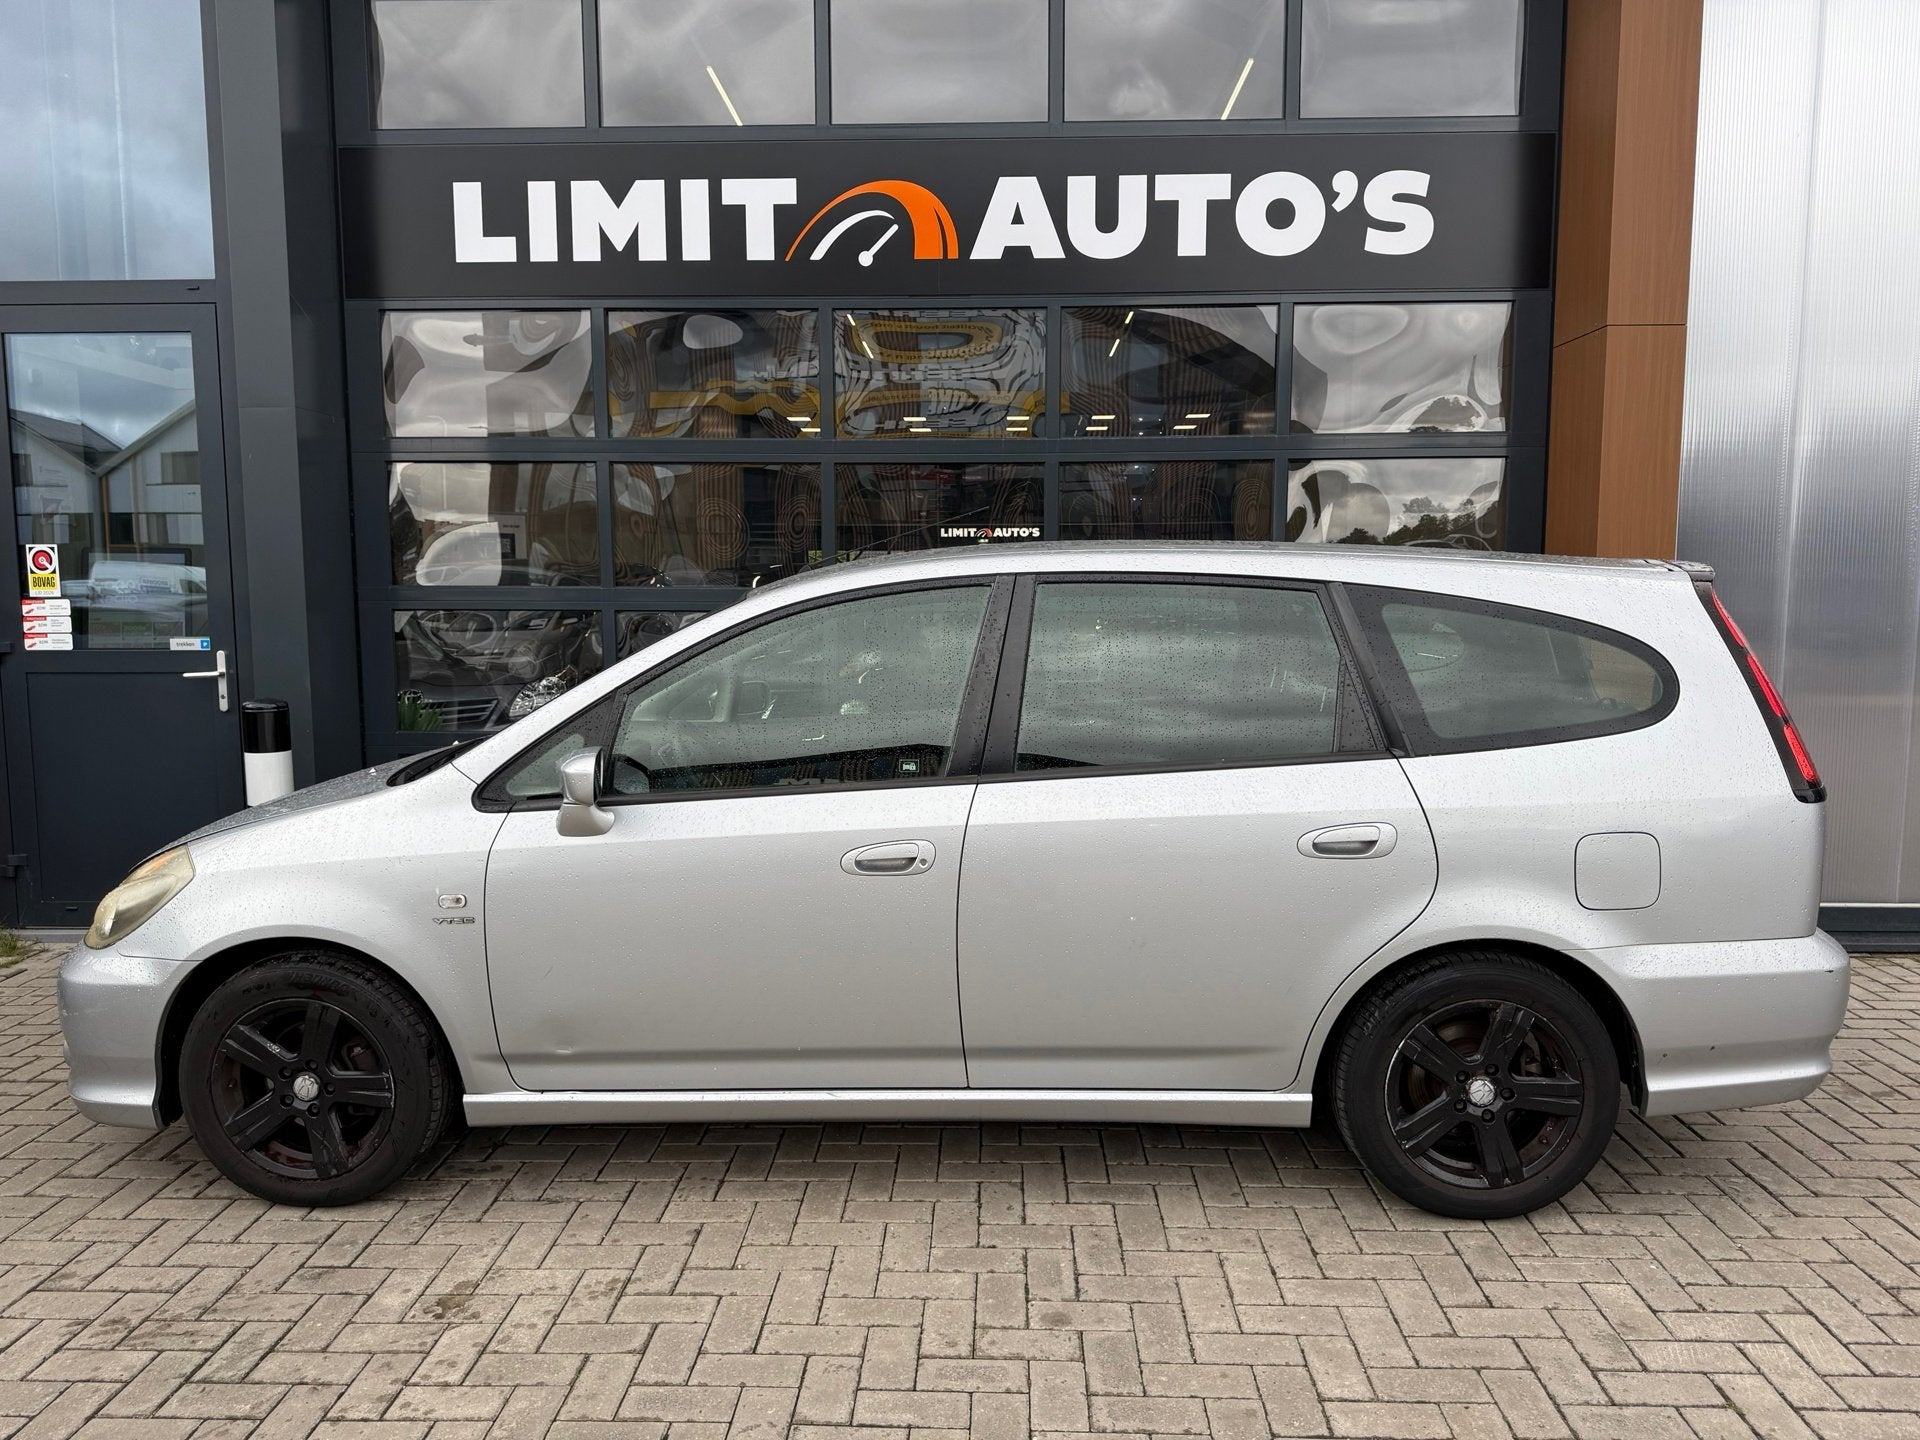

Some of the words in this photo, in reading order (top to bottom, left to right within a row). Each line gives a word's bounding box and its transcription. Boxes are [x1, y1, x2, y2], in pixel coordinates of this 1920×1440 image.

[452, 178, 798, 263] LIMIT
[968, 169, 1435, 260] AUTO'S
[940, 527, 977, 537] LIMIT
[993, 527, 1040, 537] AUTO'S
[32, 576, 56, 588] BOVAG
